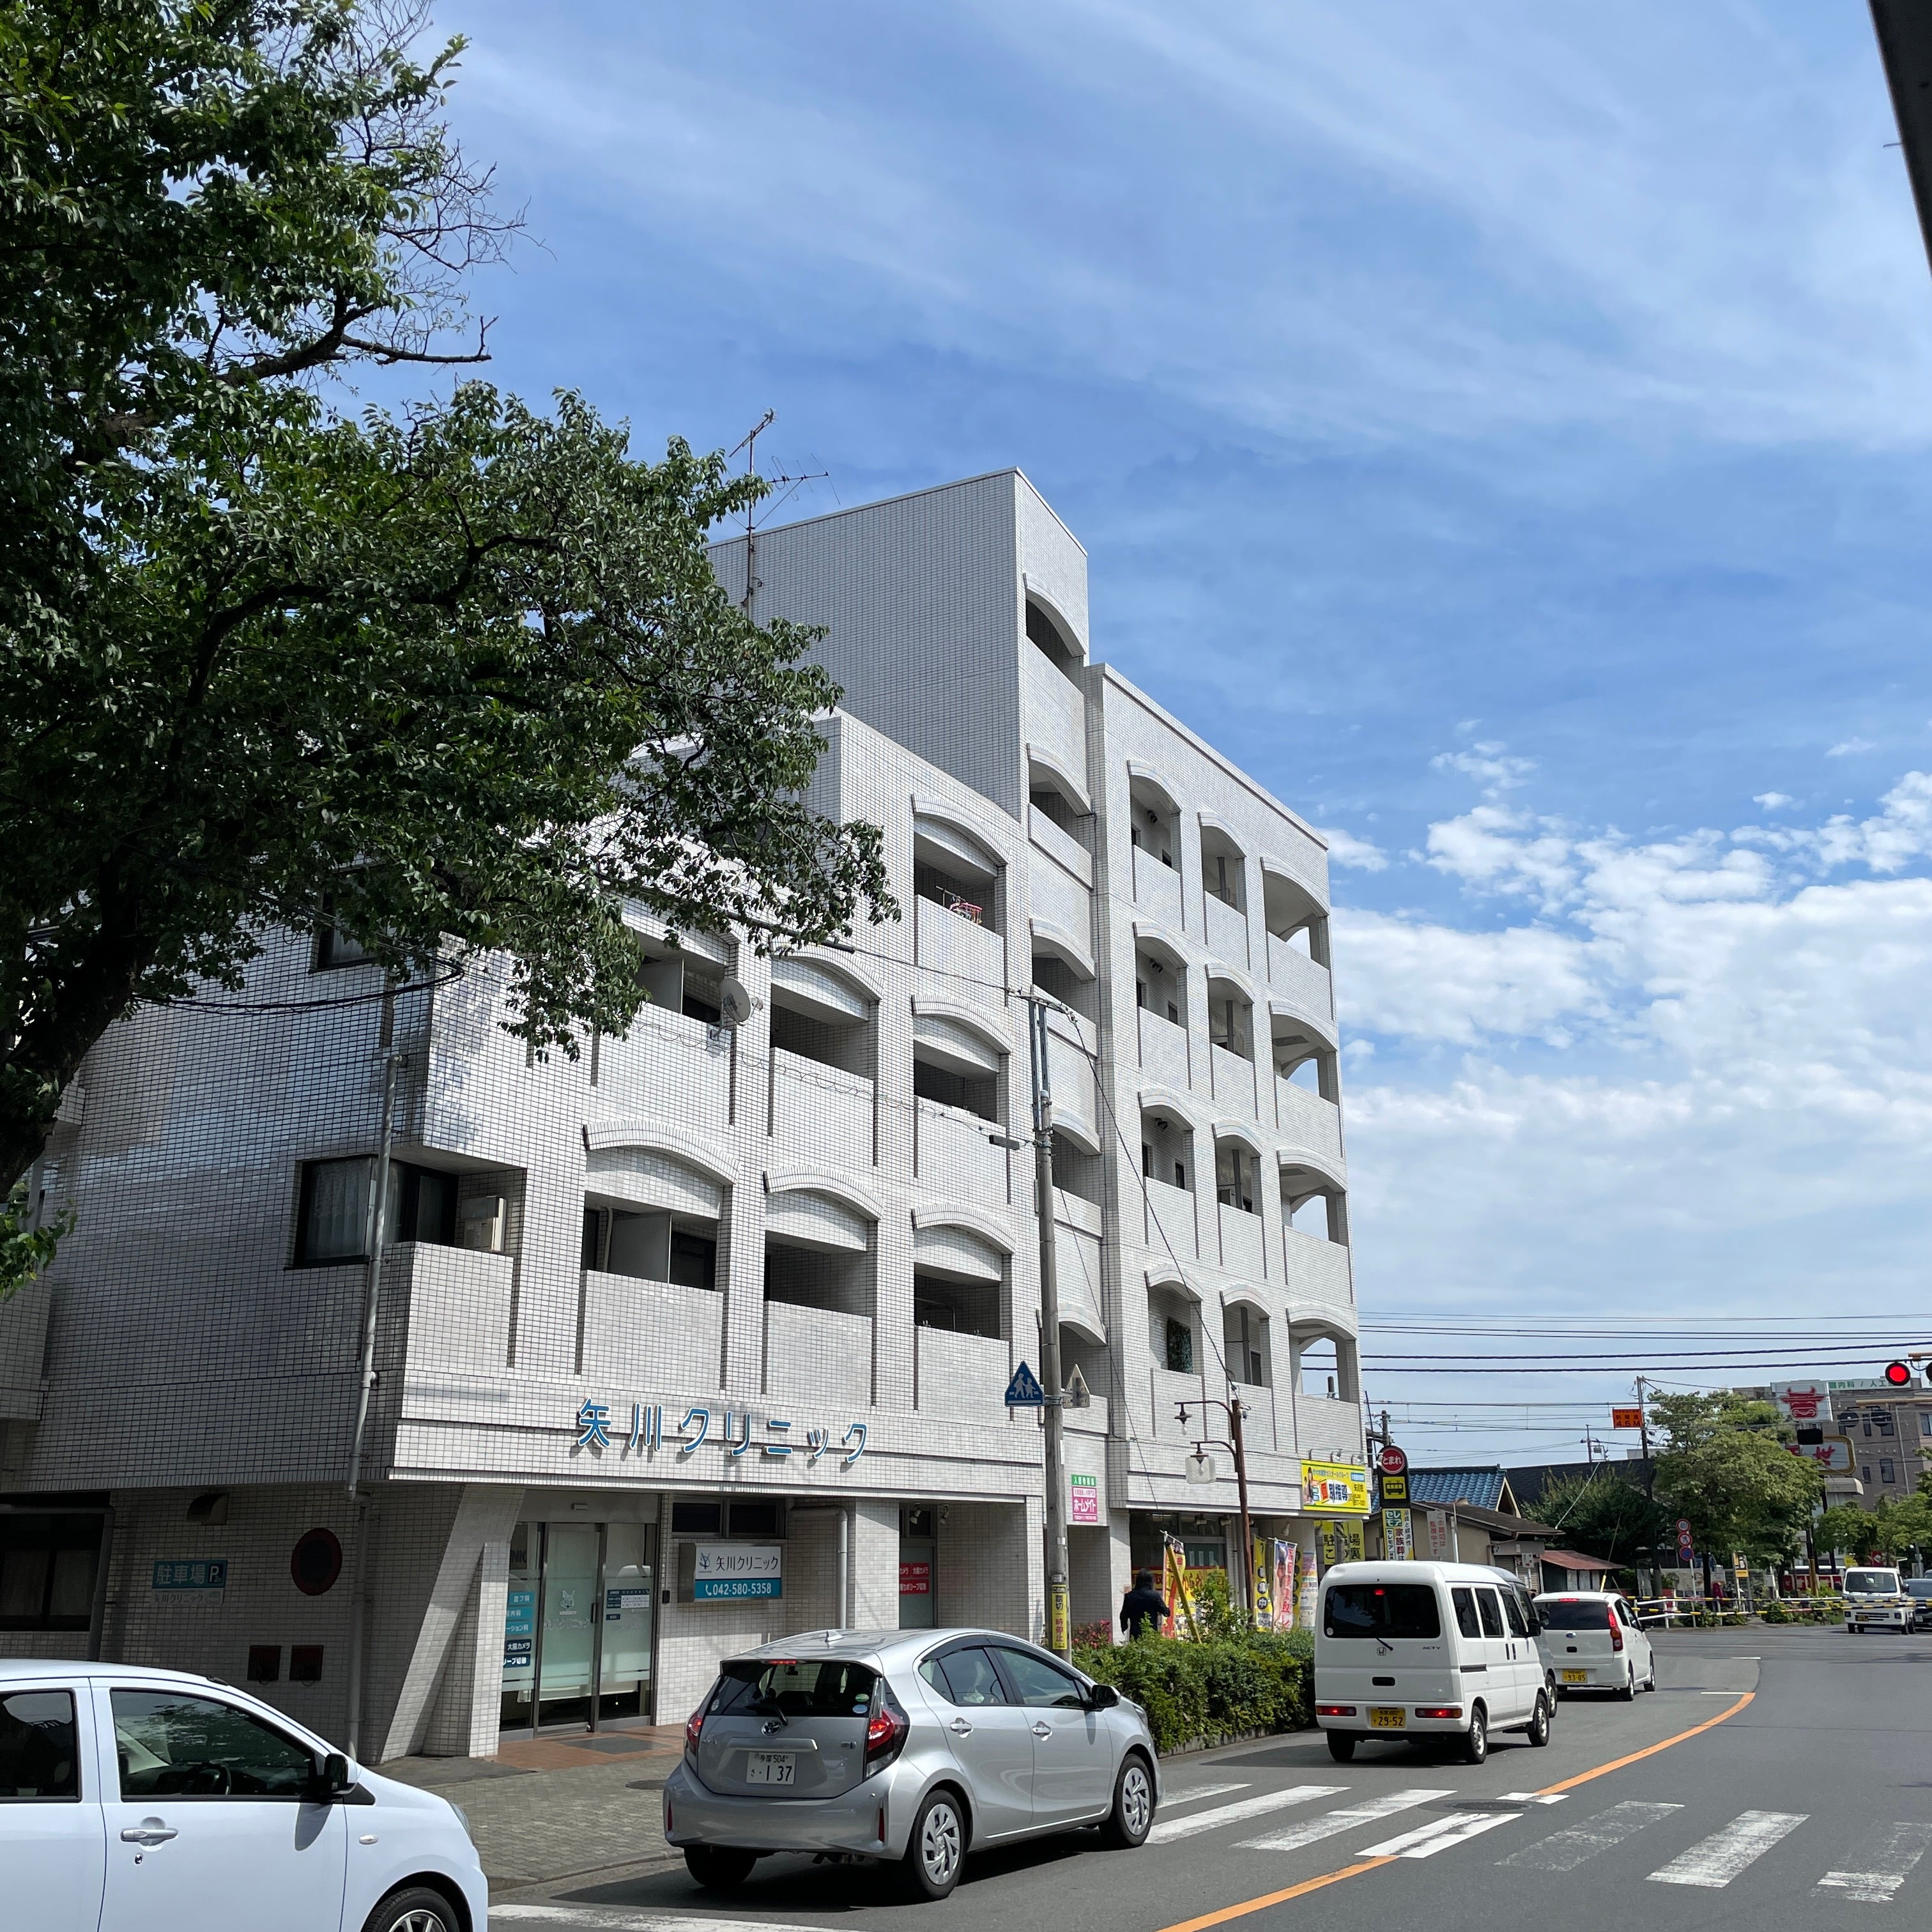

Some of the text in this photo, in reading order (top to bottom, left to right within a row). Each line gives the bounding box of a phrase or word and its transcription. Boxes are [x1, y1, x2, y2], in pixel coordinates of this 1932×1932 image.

[577, 1397, 867, 1463] 矢川クリニック
[1383, 1455, 1402, 1465] とまれ
[716, 1555, 778, 1571] 矢川クリニック
[157, 1564, 219, 1584] 駐車場 P
[712, 1583, 772, 1595] 042-580-5358
[1378, 1716, 1404, 1726] 29-52
